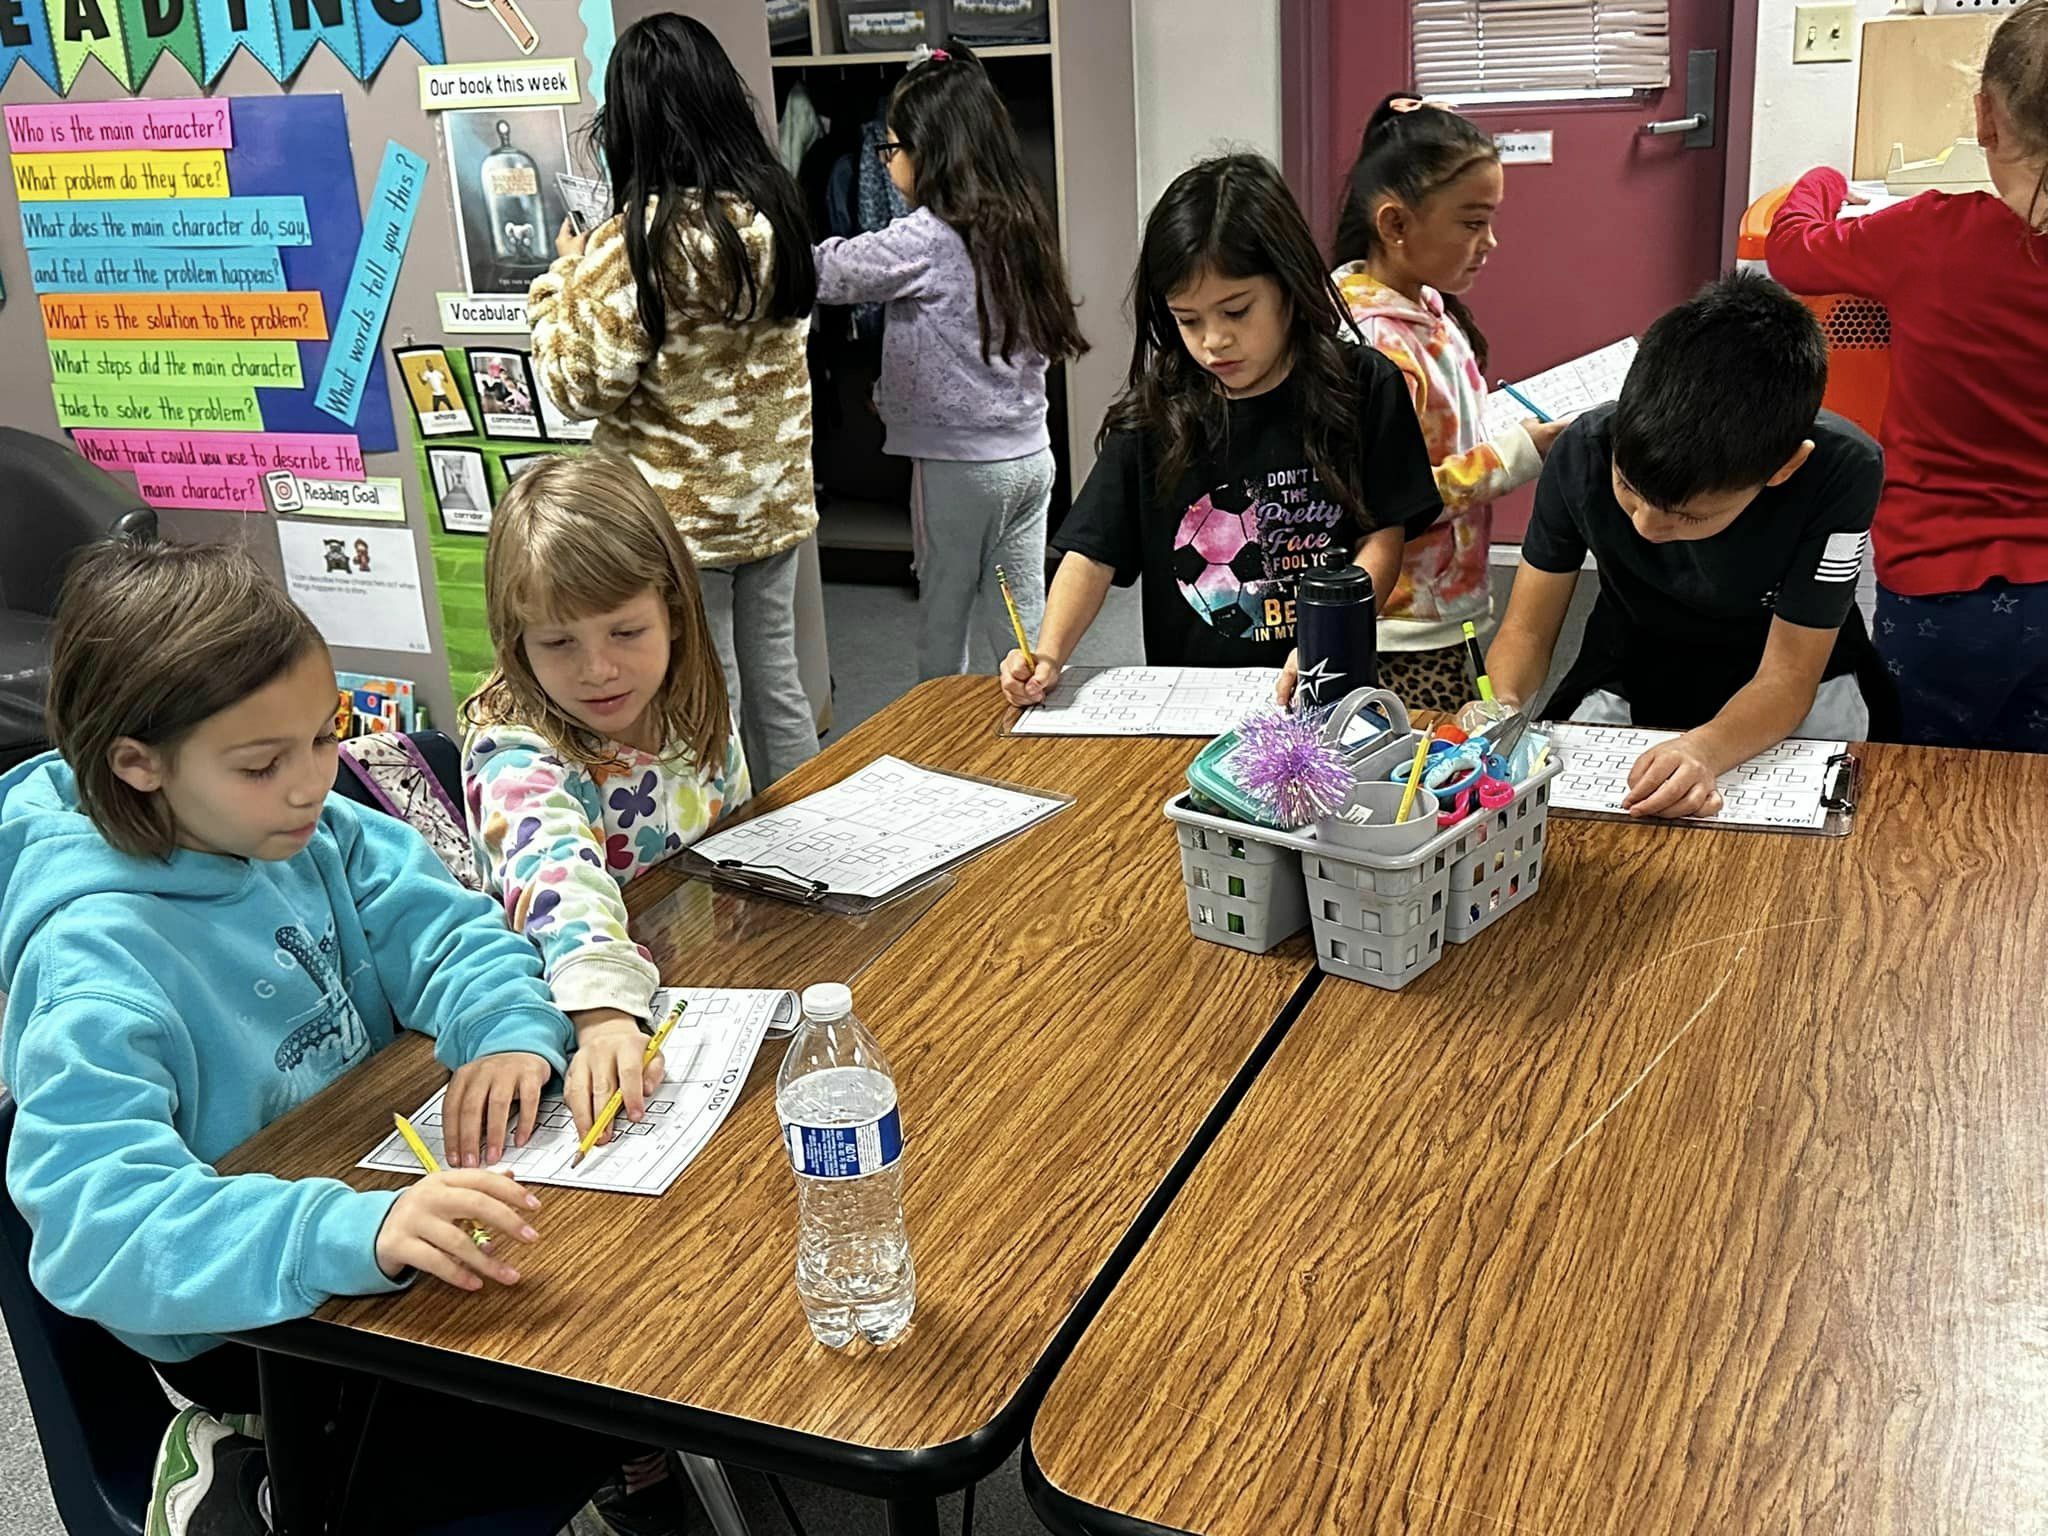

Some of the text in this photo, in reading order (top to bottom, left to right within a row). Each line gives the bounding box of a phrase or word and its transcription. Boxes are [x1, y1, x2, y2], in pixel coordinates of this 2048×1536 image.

[430, 73, 567, 96] Our book this week
[9, 110, 224, 143] Who is the main character?
[16, 161, 222, 199] What problem do they face?
[24, 209, 311, 245] What does the main character do, say,
[384, 223, 401, 260] you
[34, 257, 280, 291] and feel after the problem happens?
[361, 259, 387, 299] tell
[44, 303, 308, 336] What is the solution to the problem?
[350, 309, 375, 364] words
[51, 350, 297, 380] What steps did the main character
[325, 368, 356, 417] What
[60, 394, 253, 427] take to solve the problem?
[78, 438, 120, 466] What
[123, 440, 156, 465] trait
[161, 441, 196, 465] could
[227, 451, 248, 466] use
[251, 444, 266, 468] to
[273, 444, 331, 472] describe
[335, 446, 362, 472] the
[142, 476, 254, 502] main character?
[303, 482, 380, 505] Reading Goal
[1267, 468, 1308, 487] DON'T
[1281, 488, 1308, 504] THE
[1258, 500, 1343, 531] Pretty
[1267, 527, 1331, 553] Face
[1273, 553, 1328, 571] FOOL YO
[1255, 624, 1295, 642] IN MY
